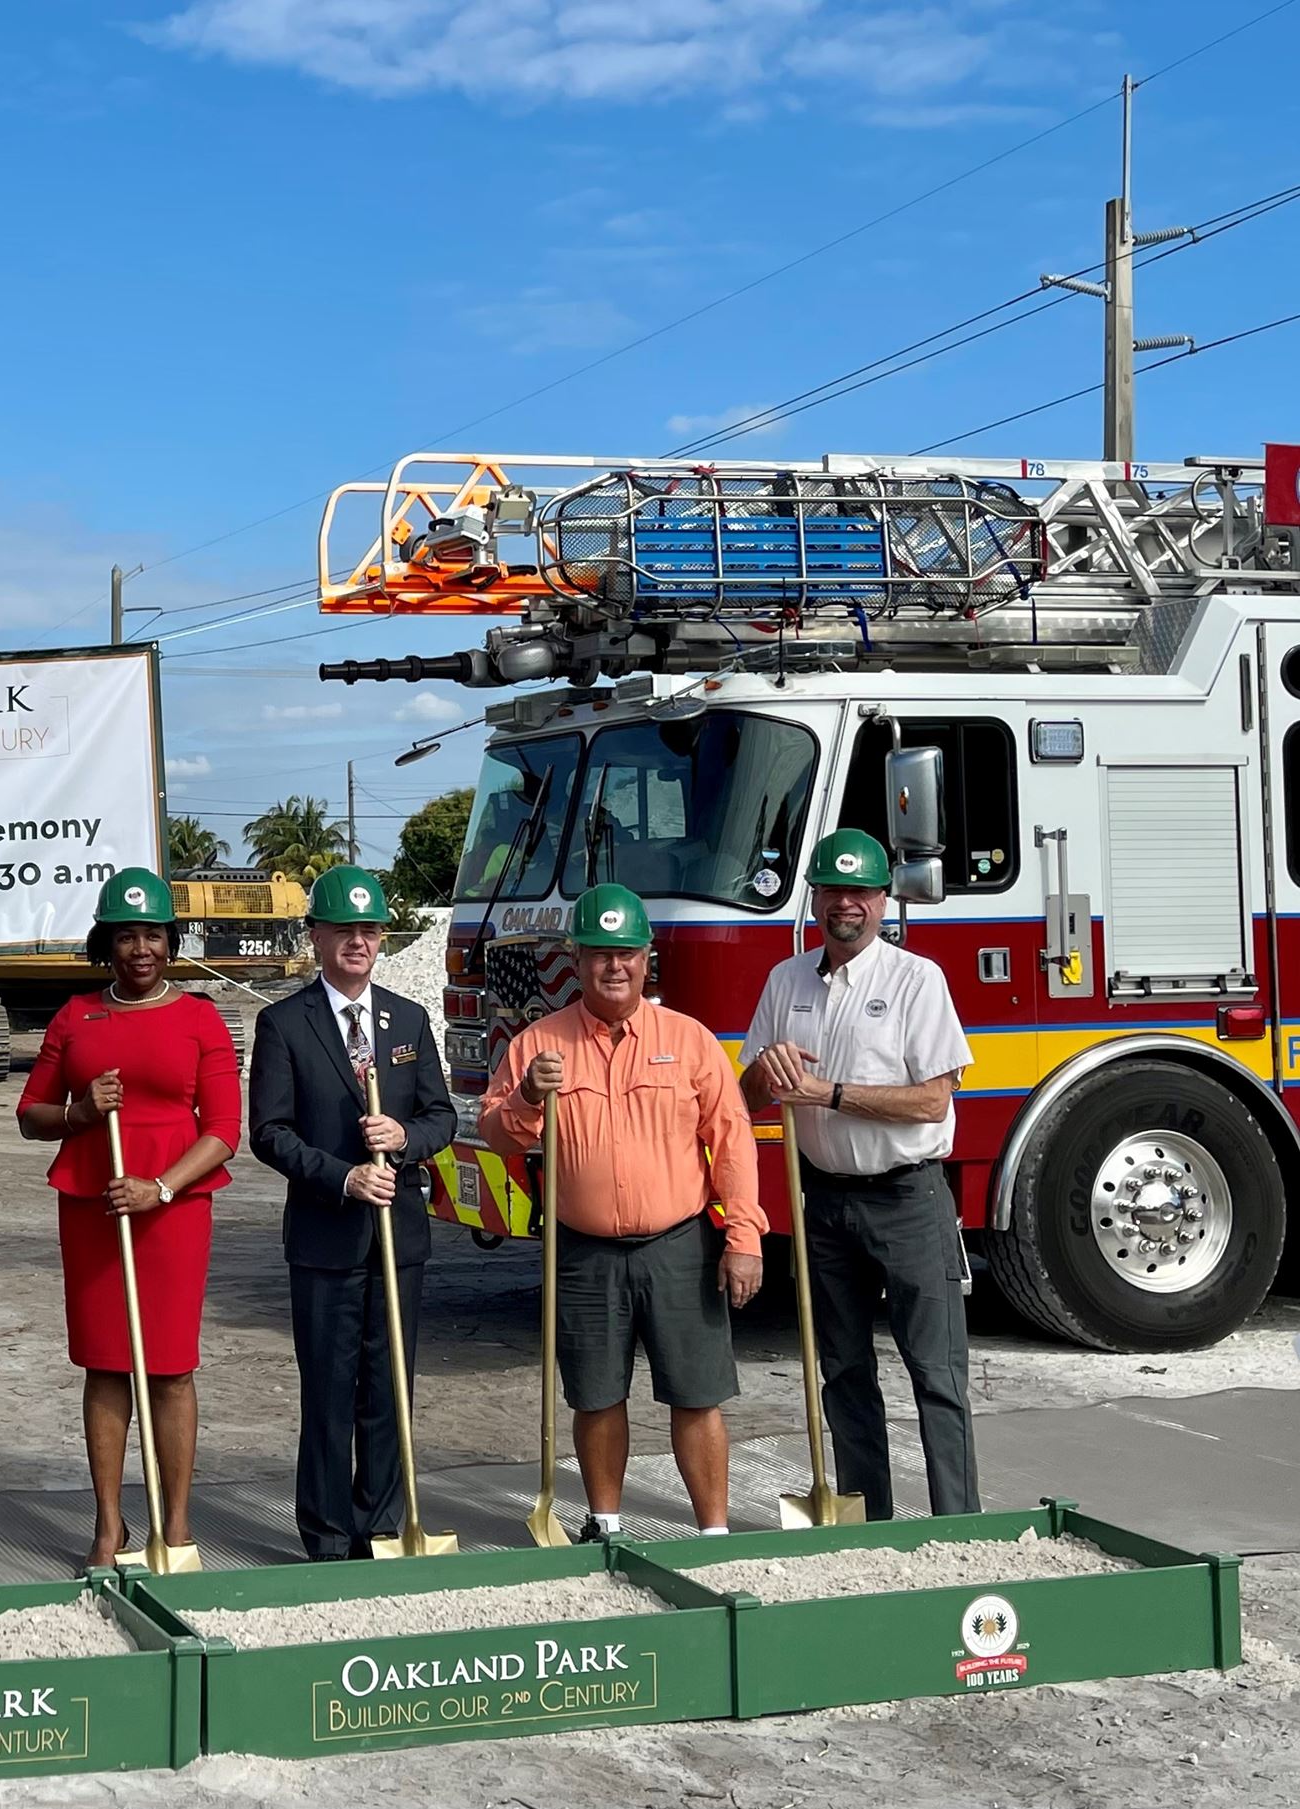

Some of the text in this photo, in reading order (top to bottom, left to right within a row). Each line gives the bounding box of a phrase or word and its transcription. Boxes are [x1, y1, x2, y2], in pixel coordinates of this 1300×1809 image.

[1028, 463, 1045, 476] 78
[1131, 464, 1149, 478] 75
[53, 862, 115, 885] a.m
[190, 922, 203, 934] 30
[502, 907, 562, 931] OAKLAND
[238, 939, 272, 955] 325C
[341, 1639, 629, 1697] OAKLAND PARK
[966, 1668, 1019, 1688] 100 YEARS
[329, 1681, 640, 1732] BUILDING OUR 2ND CENTURY
